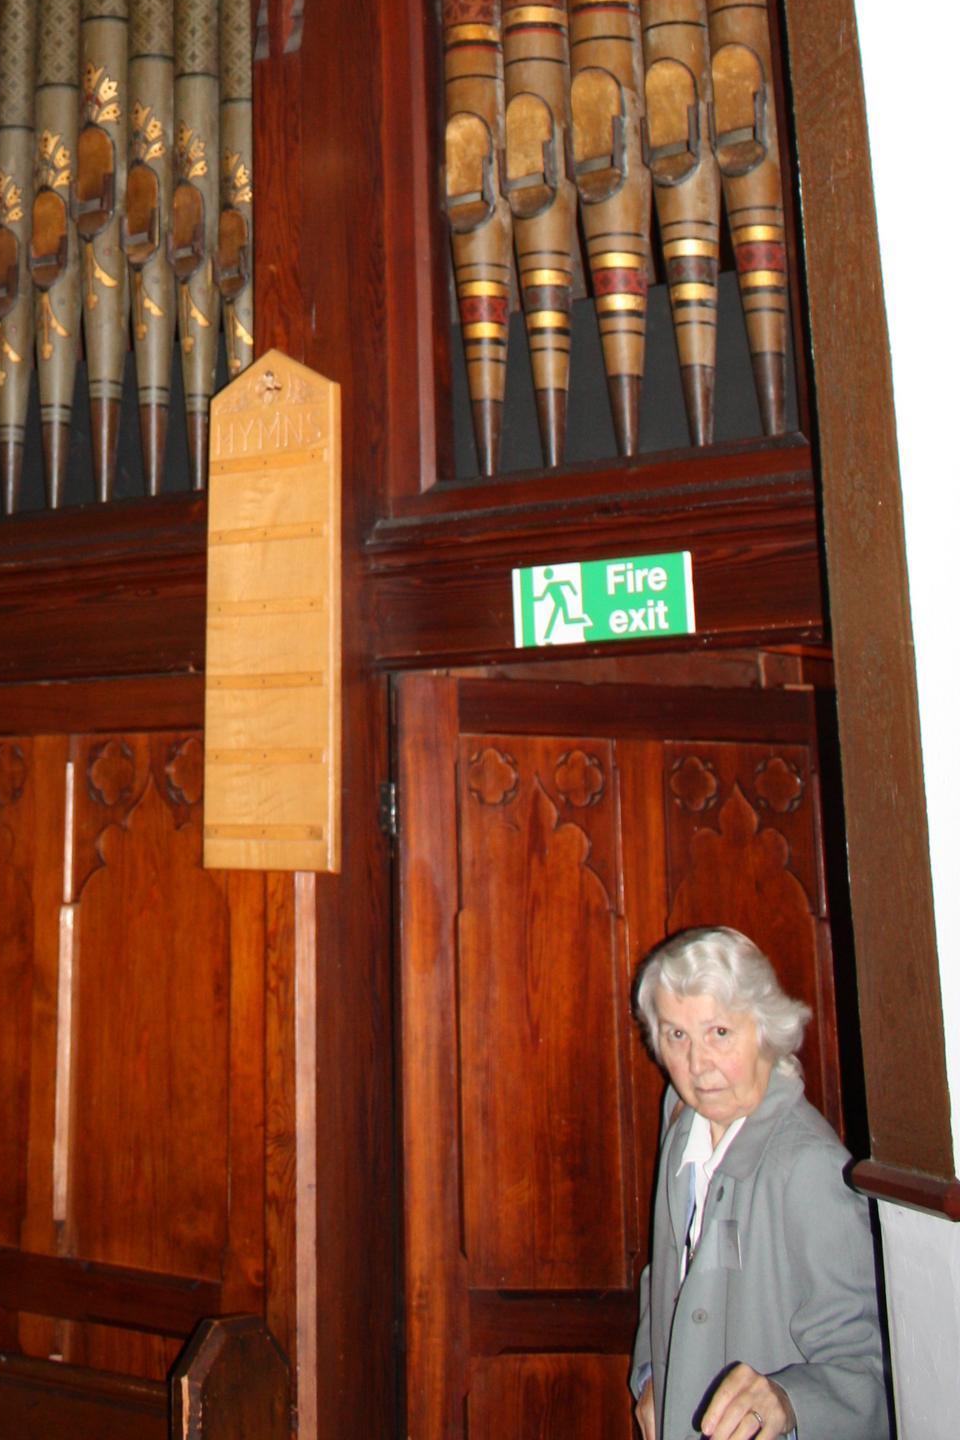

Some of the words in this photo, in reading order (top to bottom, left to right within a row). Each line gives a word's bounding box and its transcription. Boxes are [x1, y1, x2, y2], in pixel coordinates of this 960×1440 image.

[216, 410, 322, 456] HYMNS
[606, 562, 668, 596] Fire
[608, 599, 669, 634] exit
